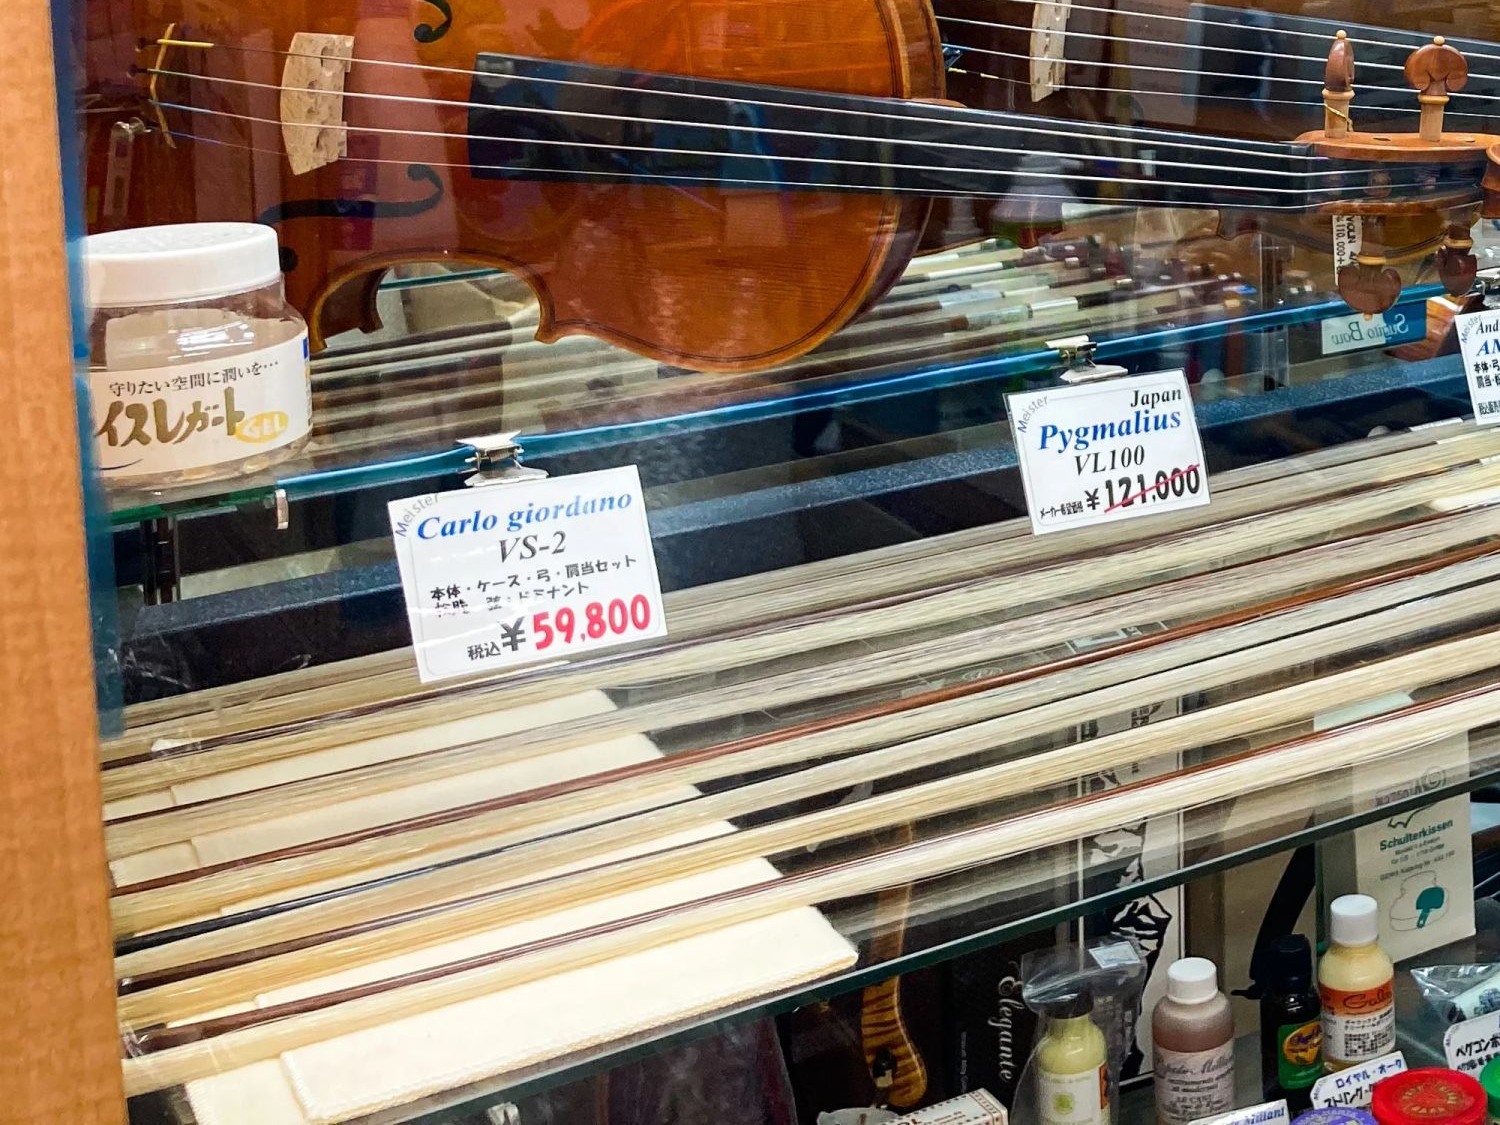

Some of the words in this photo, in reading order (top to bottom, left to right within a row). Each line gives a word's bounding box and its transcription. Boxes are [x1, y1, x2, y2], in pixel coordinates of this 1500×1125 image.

[1017, 396, 1048, 433] Meister
[1130, 388, 1182, 409] Japan
[1039, 411, 1181, 454] Pygmalius
[1075, 445, 1145, 475] VL100
[394, 493, 440, 538] Meister
[417, 510, 498, 540] Carlo
[507, 493, 632, 532] giordano
[498, 530, 567, 564] VS-2
[430, 555, 637, 601] 本体・ケース・弓・肩当セット
[1380, 819, 1453, 851] Schulterkissen
[987, 975, 1023, 1081] Elegante
